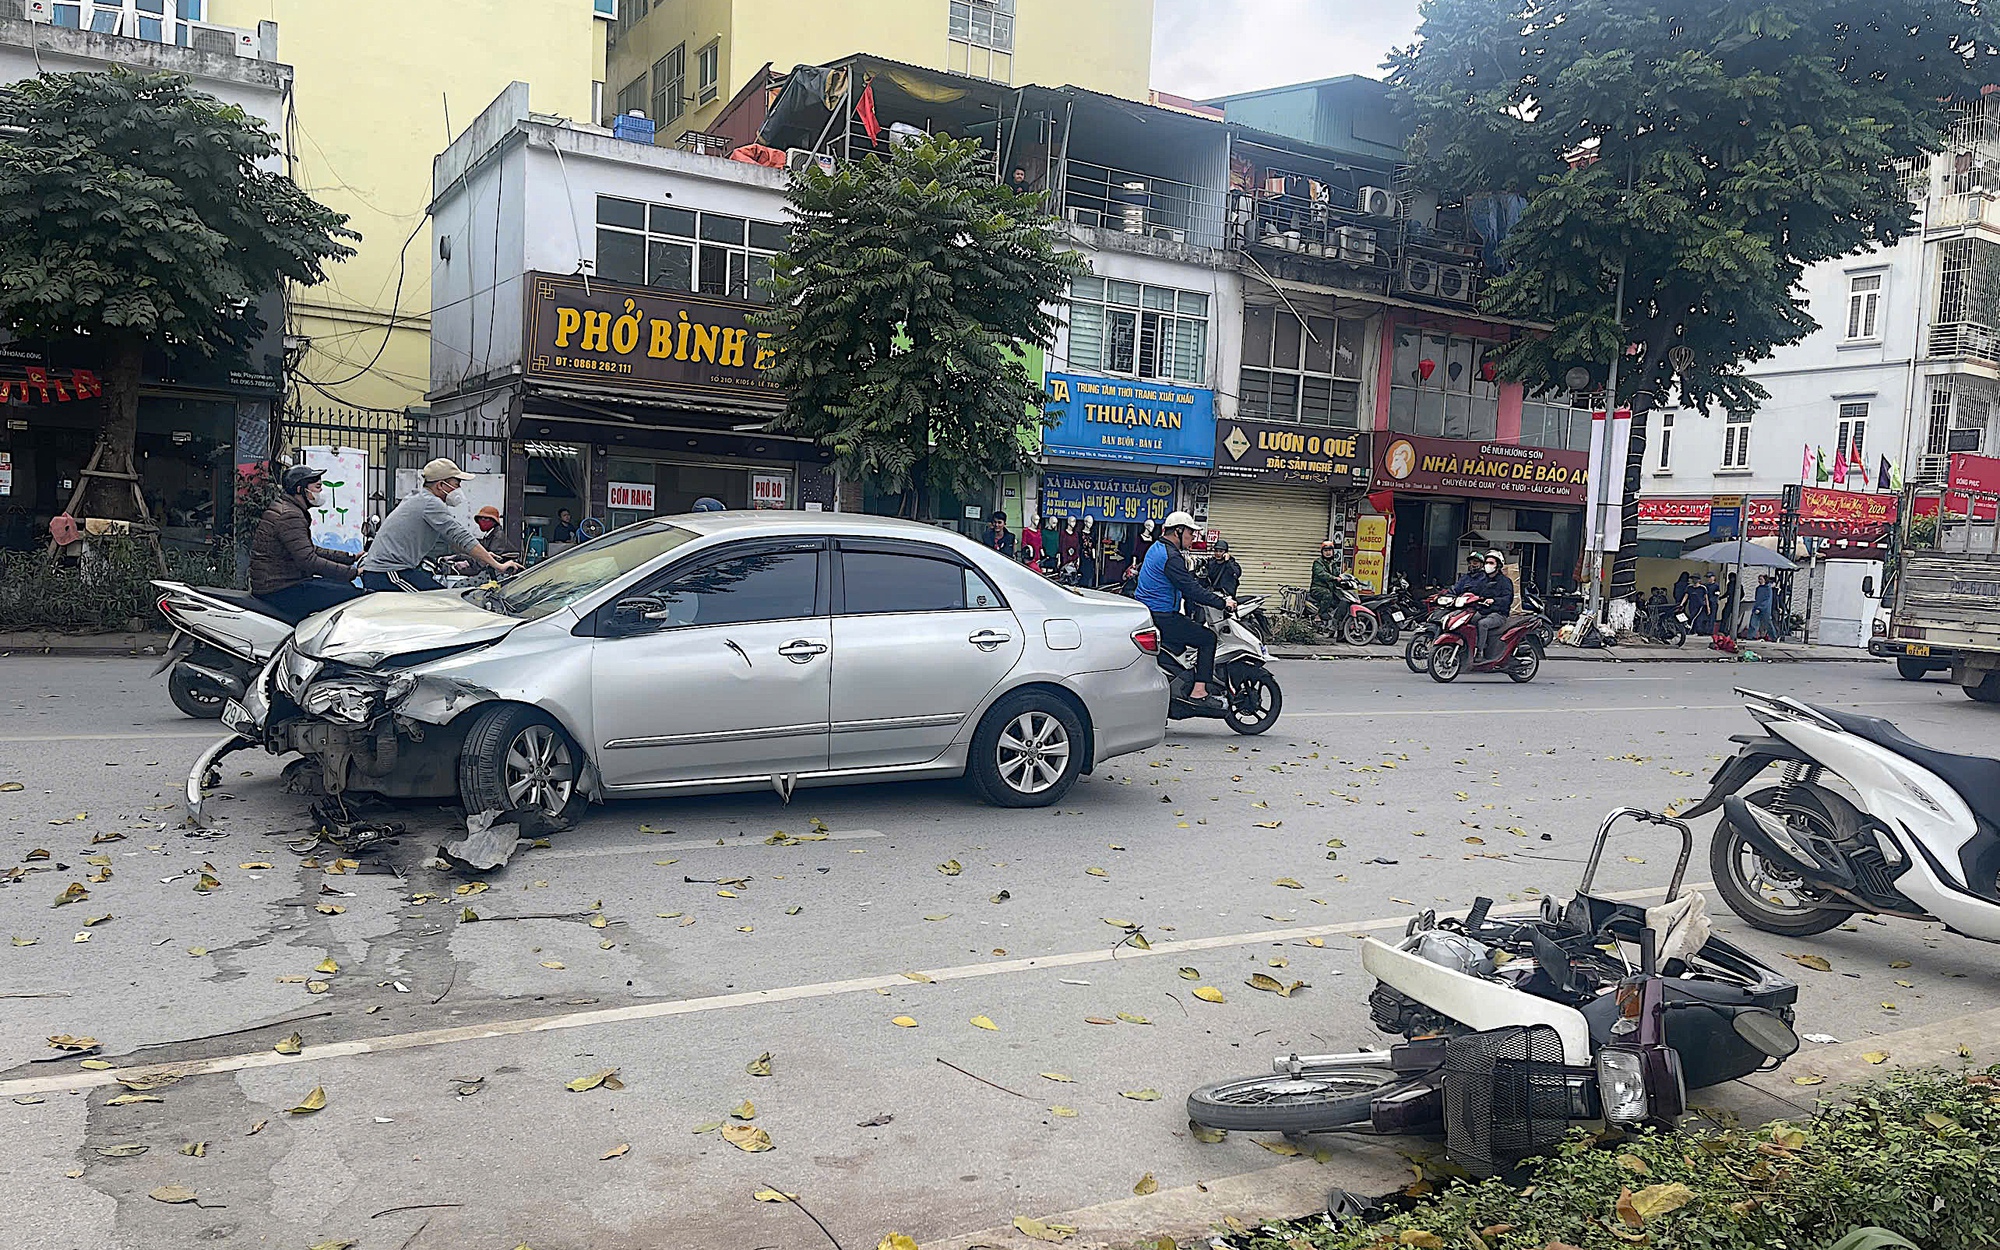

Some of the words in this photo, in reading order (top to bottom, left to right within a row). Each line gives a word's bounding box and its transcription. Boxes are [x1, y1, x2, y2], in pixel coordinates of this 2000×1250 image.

[555, 298, 644, 354] PHỞ
[647, 311, 748, 367] BÌNH
[573, 358, 597, 370] 0868
[598, 361, 616, 373] 262
[618, 363, 632, 374] 111
[1050, 379, 1071, 403] TA
[1076, 382, 1100, 394] TRUNG
[1134, 389, 1157, 400] TRANG
[1085, 403, 1152, 429] THUẬN
[1153, 411, 1182, 429] AN
[1258, 431, 1305, 453] LƯƠN
[1322, 433, 1360, 458] QUẾ
[1266, 455, 1287, 472] ĐẶC
[1286, 456, 1308, 471] SẢN
[1307, 460, 1333, 476] NGHỆ
[1333, 463, 1348, 475] AN
[1421, 453, 1458, 474] NHÀ
[1460, 455, 1509, 478] HÀNG
[1511, 460, 1533, 480] DÊ
[1534, 460, 1568, 483] BẢO
[755, 478, 771, 498] PHỞ
[1046, 474, 1061, 488] XẢ
[1063, 477, 1091, 490] HÀNG
[1093, 478, 1120, 492] XUẤT
[1121, 479, 1148, 494] KHẨU
[610, 486, 629, 505] CƠM
[631, 489, 652, 507] RANG
